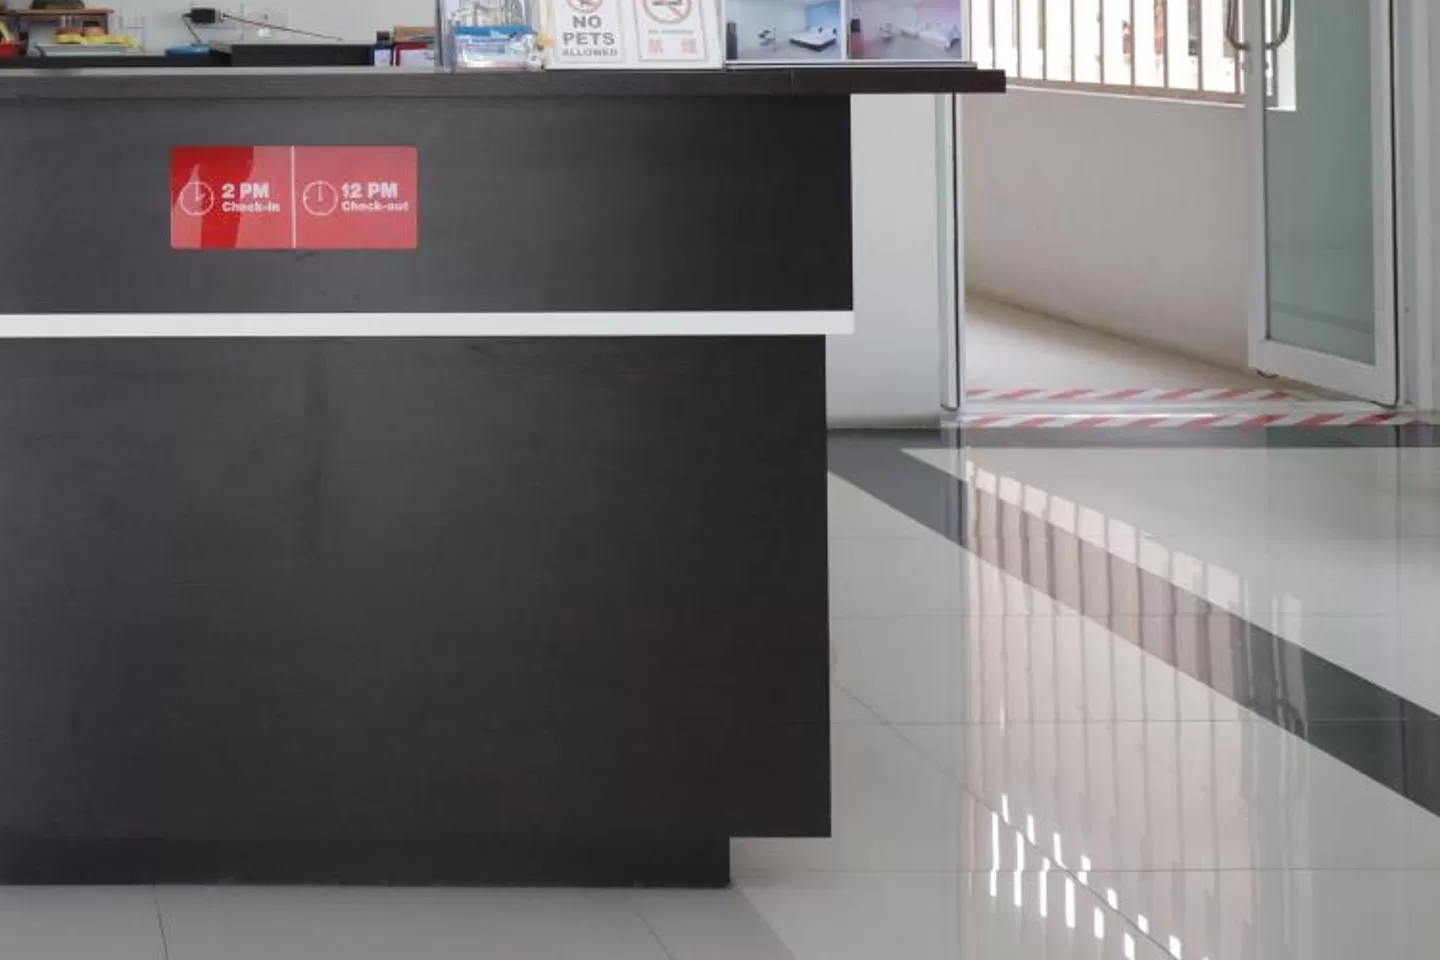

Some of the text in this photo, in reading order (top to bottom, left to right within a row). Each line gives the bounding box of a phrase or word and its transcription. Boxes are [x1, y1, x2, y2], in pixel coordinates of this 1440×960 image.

[572, 15, 602, 29] NO
[562, 31, 615, 46] PETS
[221, 182, 270, 199] 2 PM
[341, 181, 399, 199] 12 PM
[221, 201, 281, 213] Check-in
[341, 201, 409, 213] Check-out
